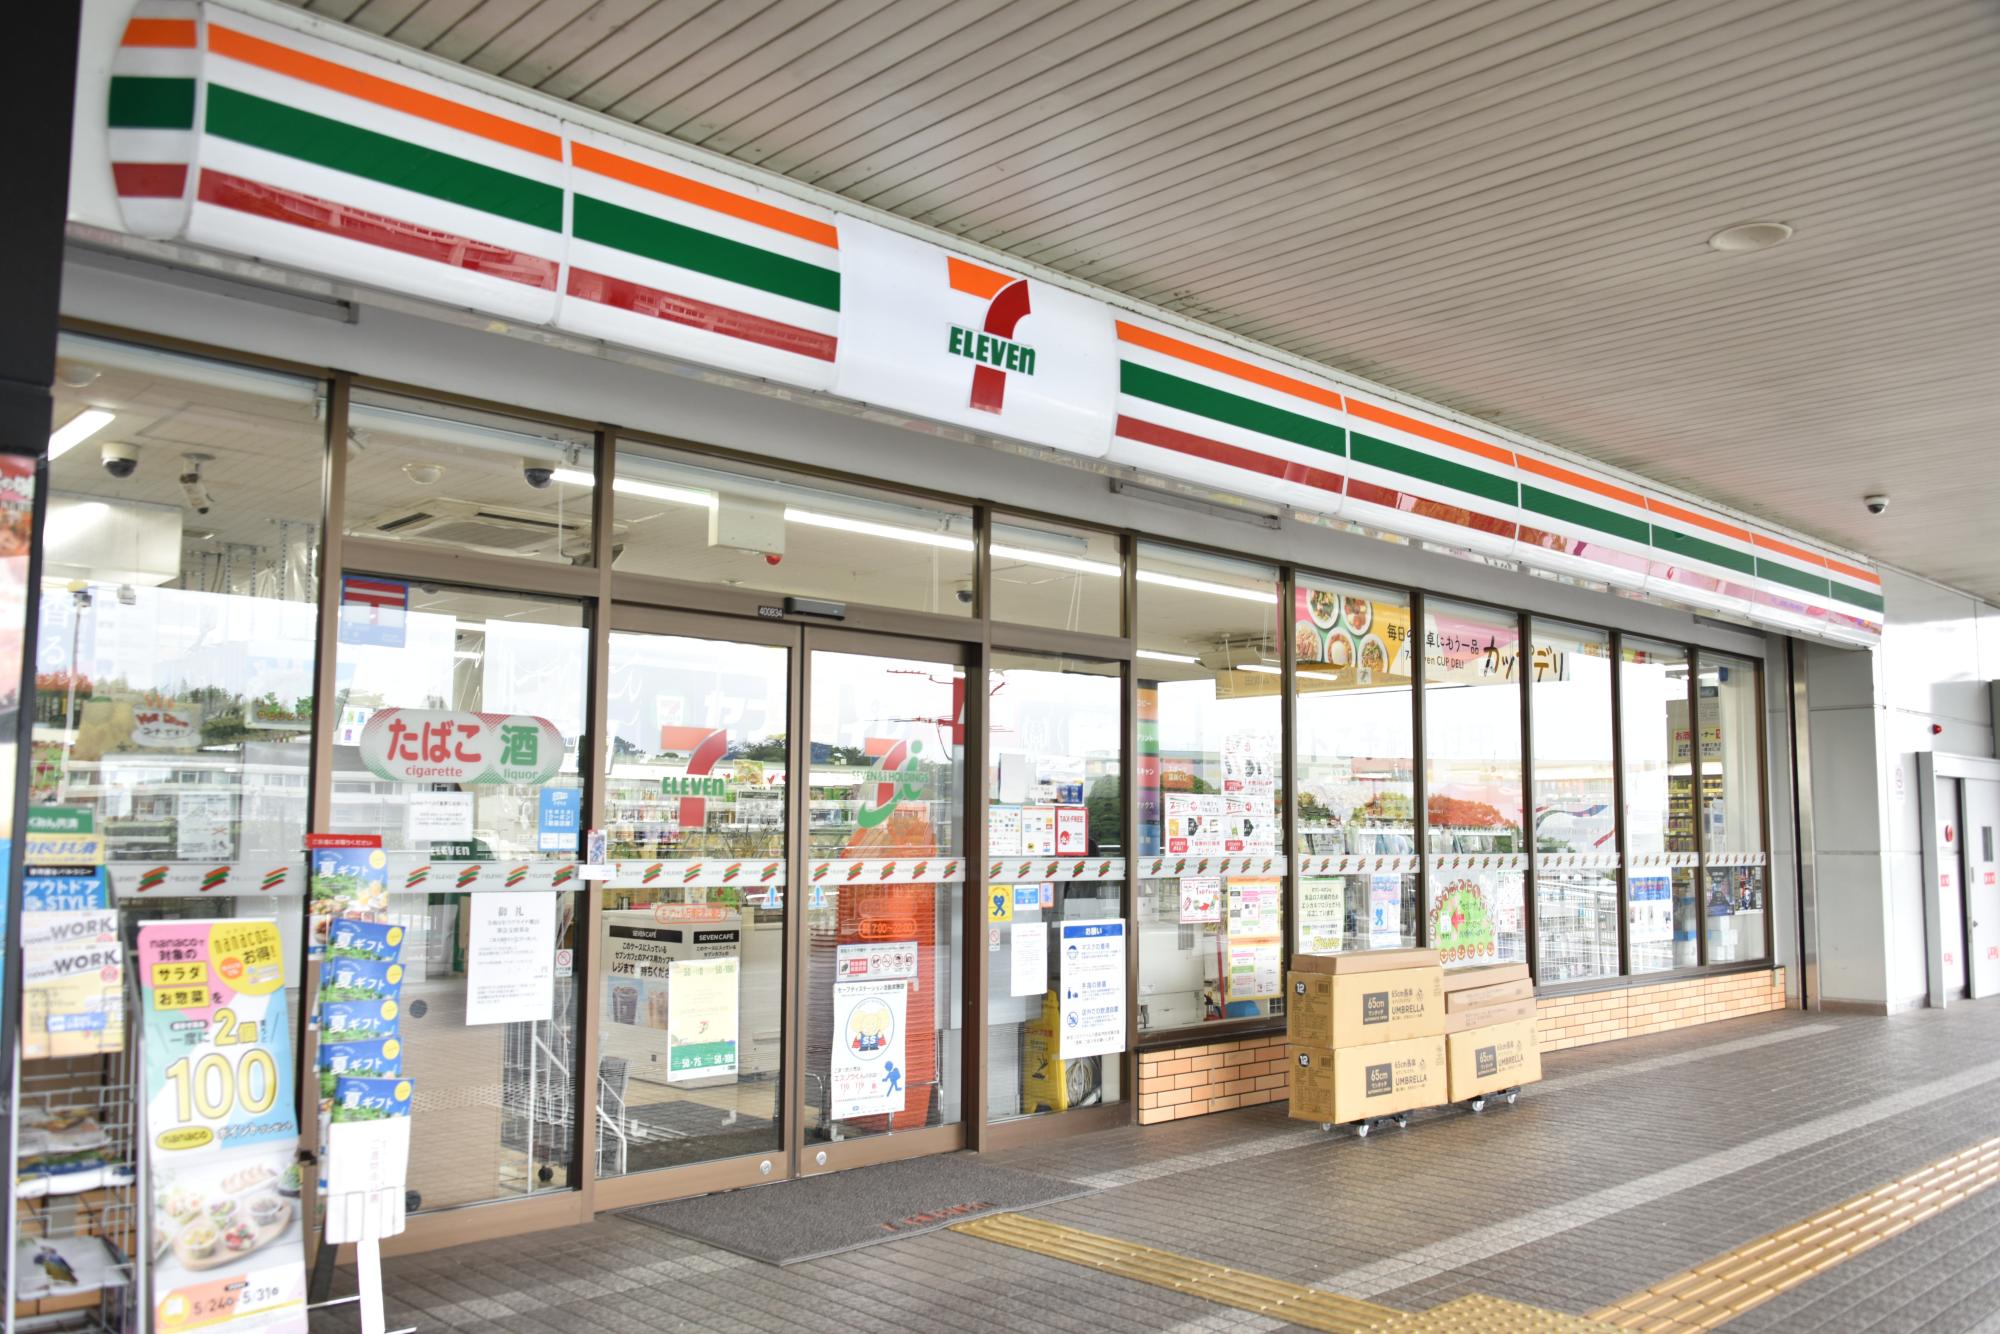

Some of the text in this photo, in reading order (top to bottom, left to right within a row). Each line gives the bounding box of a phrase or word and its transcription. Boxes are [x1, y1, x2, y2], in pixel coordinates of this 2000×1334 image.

[946, 256, 1031, 415] 7
[1387, 622, 1480, 655] 毎日卓にもう一品
[1483, 634, 1564, 683] カッデリ
[387, 718, 539, 766] たばこ 酒
[405, 765, 539, 781] cigarette liquor
[23, 881, 102, 896] アウトドア
[50, 917, 116, 939] WORK
[335, 931, 385, 951] 夏ギフト
[698, 934, 718, 942] SEVEN
[54, 949, 120, 974] WORK
[160, 948, 197, 961] 対象の
[158, 966, 200, 981] サラダ
[335, 970, 385, 991] 夏ギフト
[1297, 982, 1304, 993] 12
[212, 991, 223, 1004] を
[1368, 996, 1385, 1009] 65cm
[1391, 1003, 1425, 1015] UMBRELLA
[329, 1014, 381, 1034] 夏ギフト
[330, 1055, 383, 1075] 夏ギフト
[1300, 1055, 1308, 1064] 12
[1371, 1069, 1388, 1081] 65cm
[1396, 1074, 1427, 1086] UMBRELLA
[165, 1048, 277, 1123] 100
[342, 1091, 394, 1110] 夏ギフト
